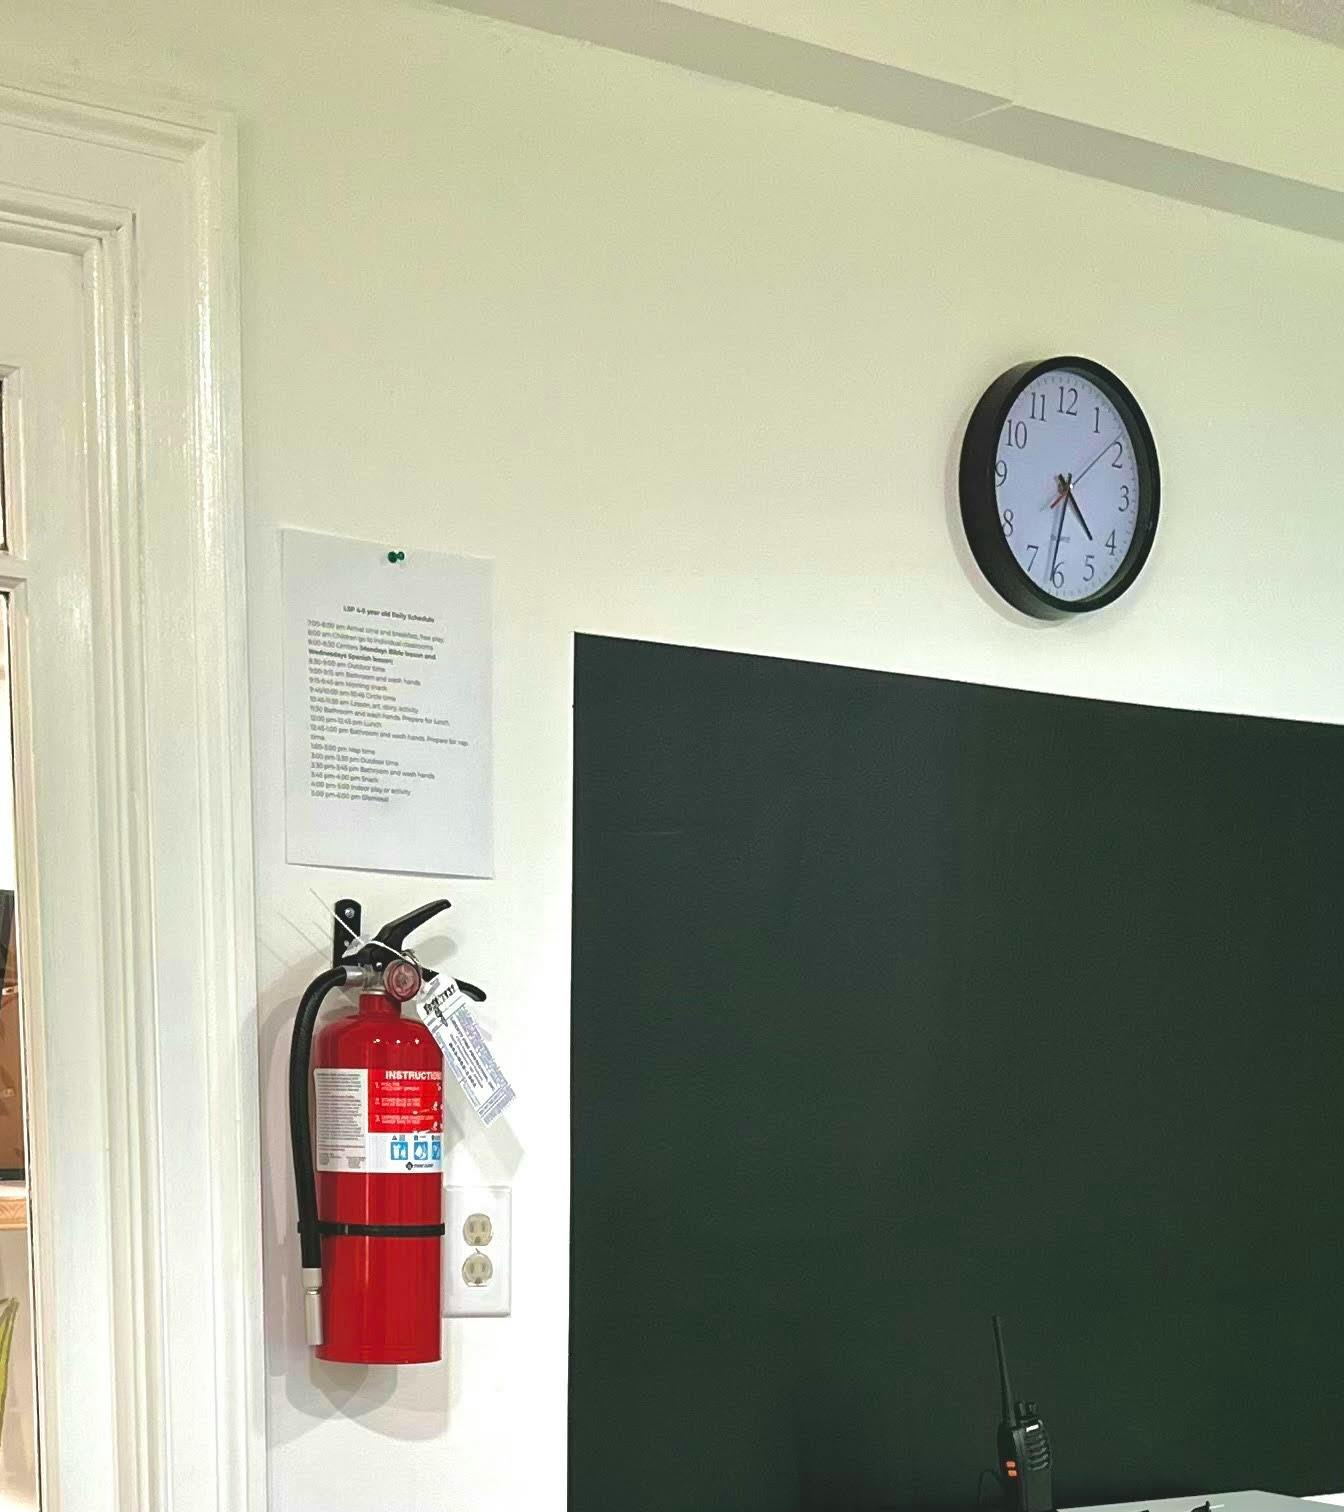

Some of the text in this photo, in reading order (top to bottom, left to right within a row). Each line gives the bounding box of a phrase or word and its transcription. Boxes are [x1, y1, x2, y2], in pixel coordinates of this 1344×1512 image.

[1029, 392, 1047, 422] 11
[1056, 386, 1078, 416] 12
[1006, 419, 1027, 449] 10
[1093, 407, 1100, 434] 1
[1112, 442, 1123, 469] 2
[994, 460, 1008, 487] 9
[1118, 485, 1130, 512] 3
[1002, 508, 1014, 537] 8
[1105, 529, 1117, 556] 4
[1026, 544, 1039, 572] 7
[1083, 555, 1095, 582] 5
[1052, 562, 1065, 589] 6
